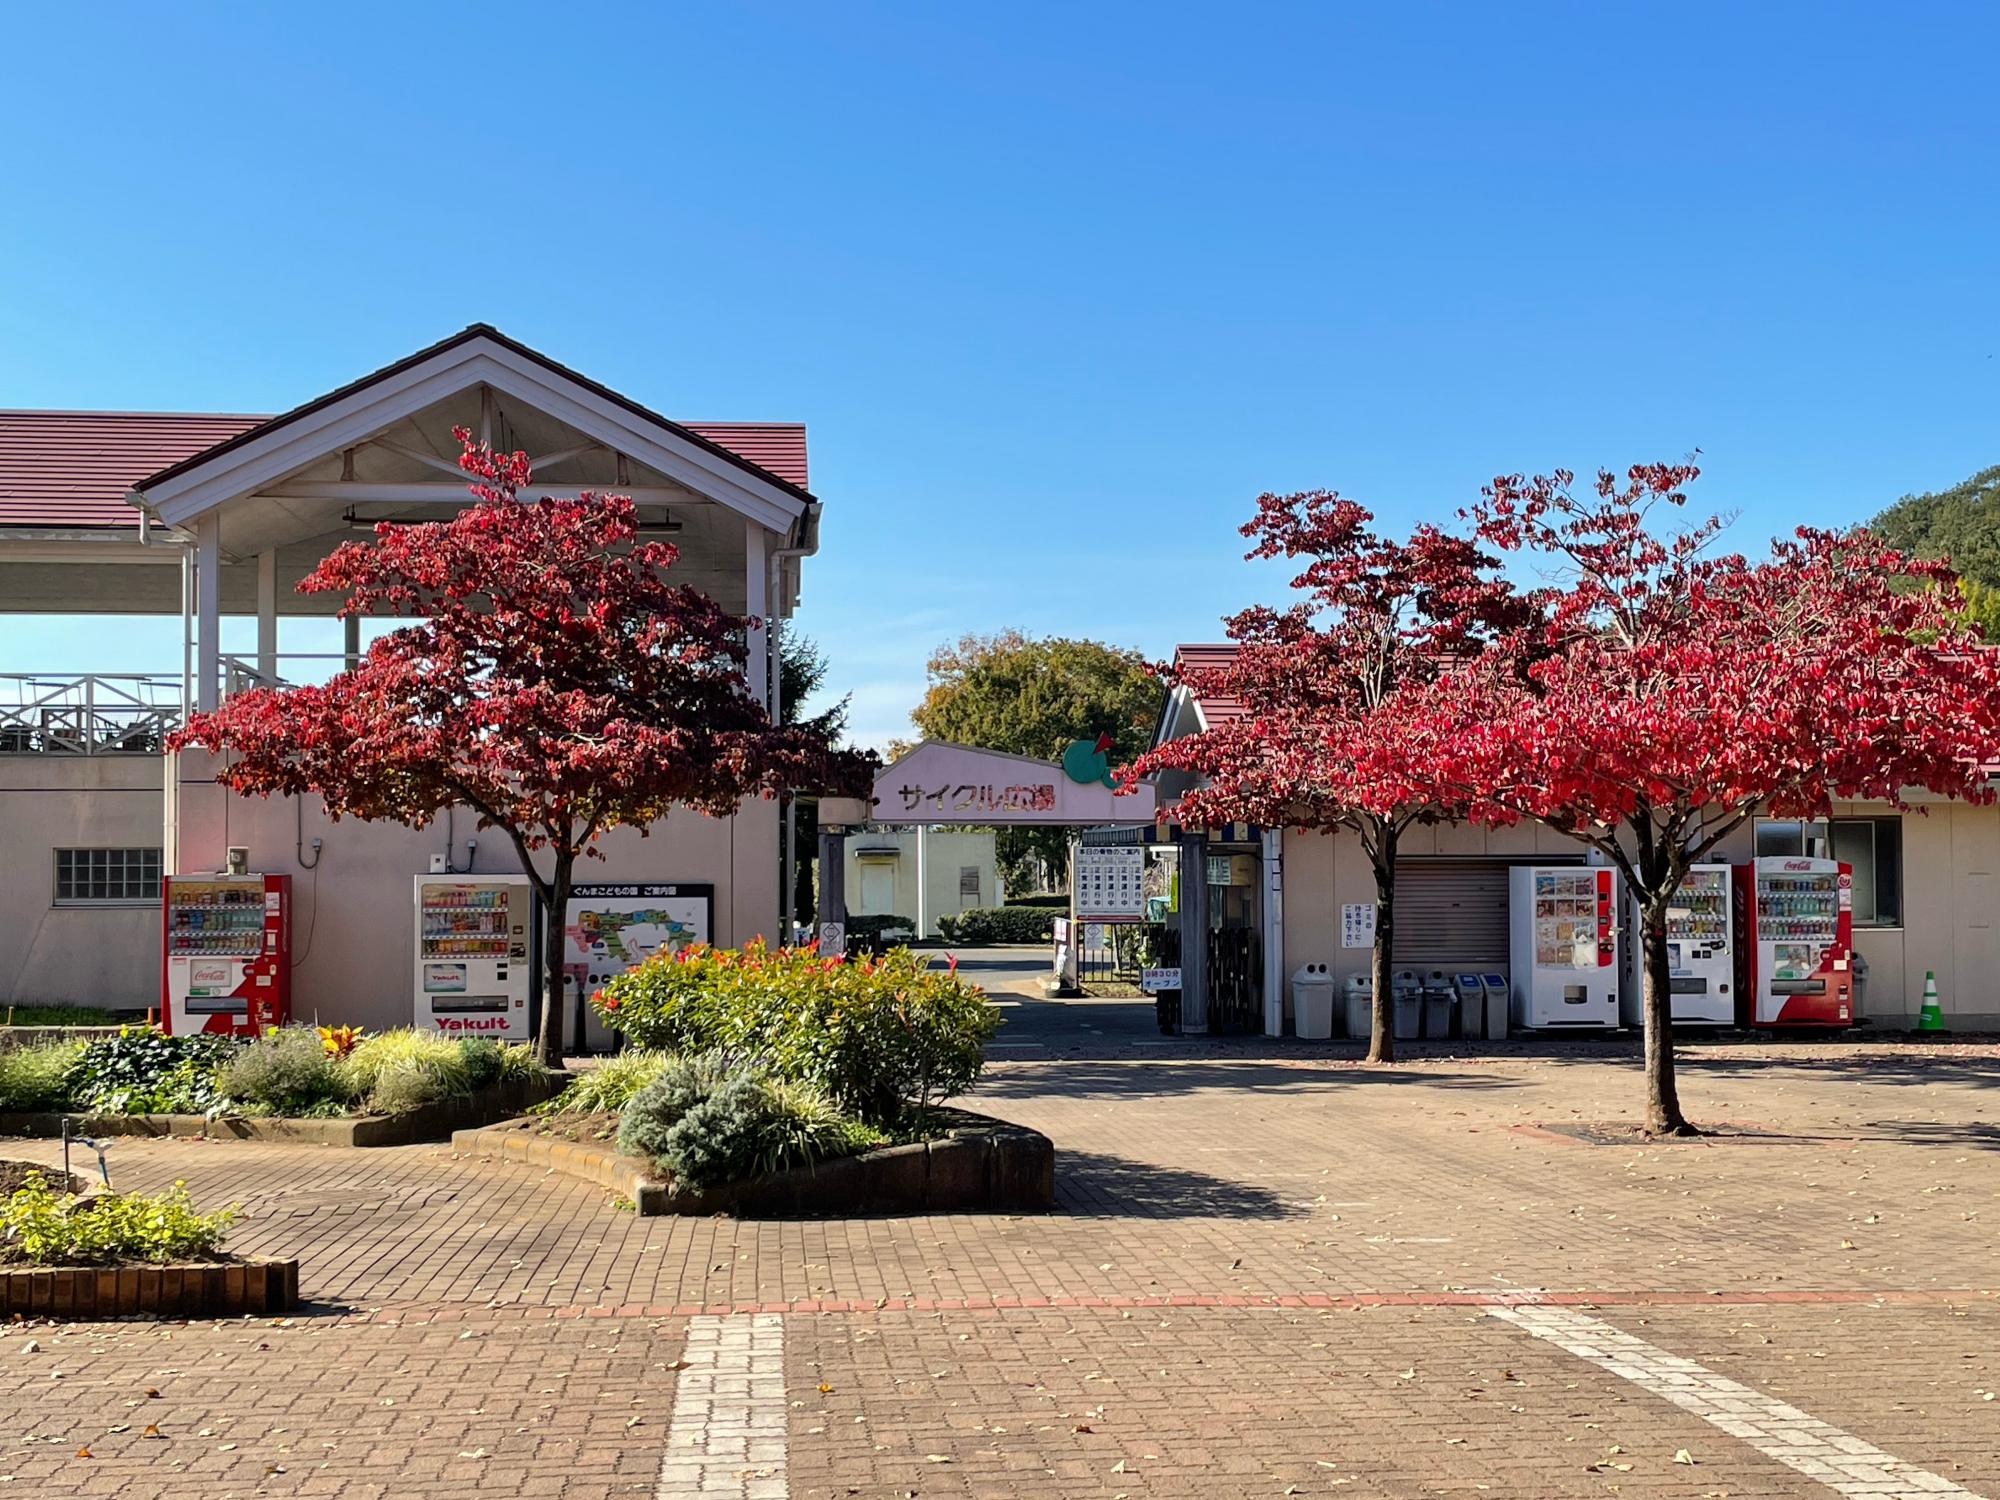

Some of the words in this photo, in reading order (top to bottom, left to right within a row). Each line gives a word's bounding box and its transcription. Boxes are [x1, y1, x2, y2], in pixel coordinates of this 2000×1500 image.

[898, 784, 1056, 811] サイクル広場
[435, 1017, 511, 1030] Yakult
